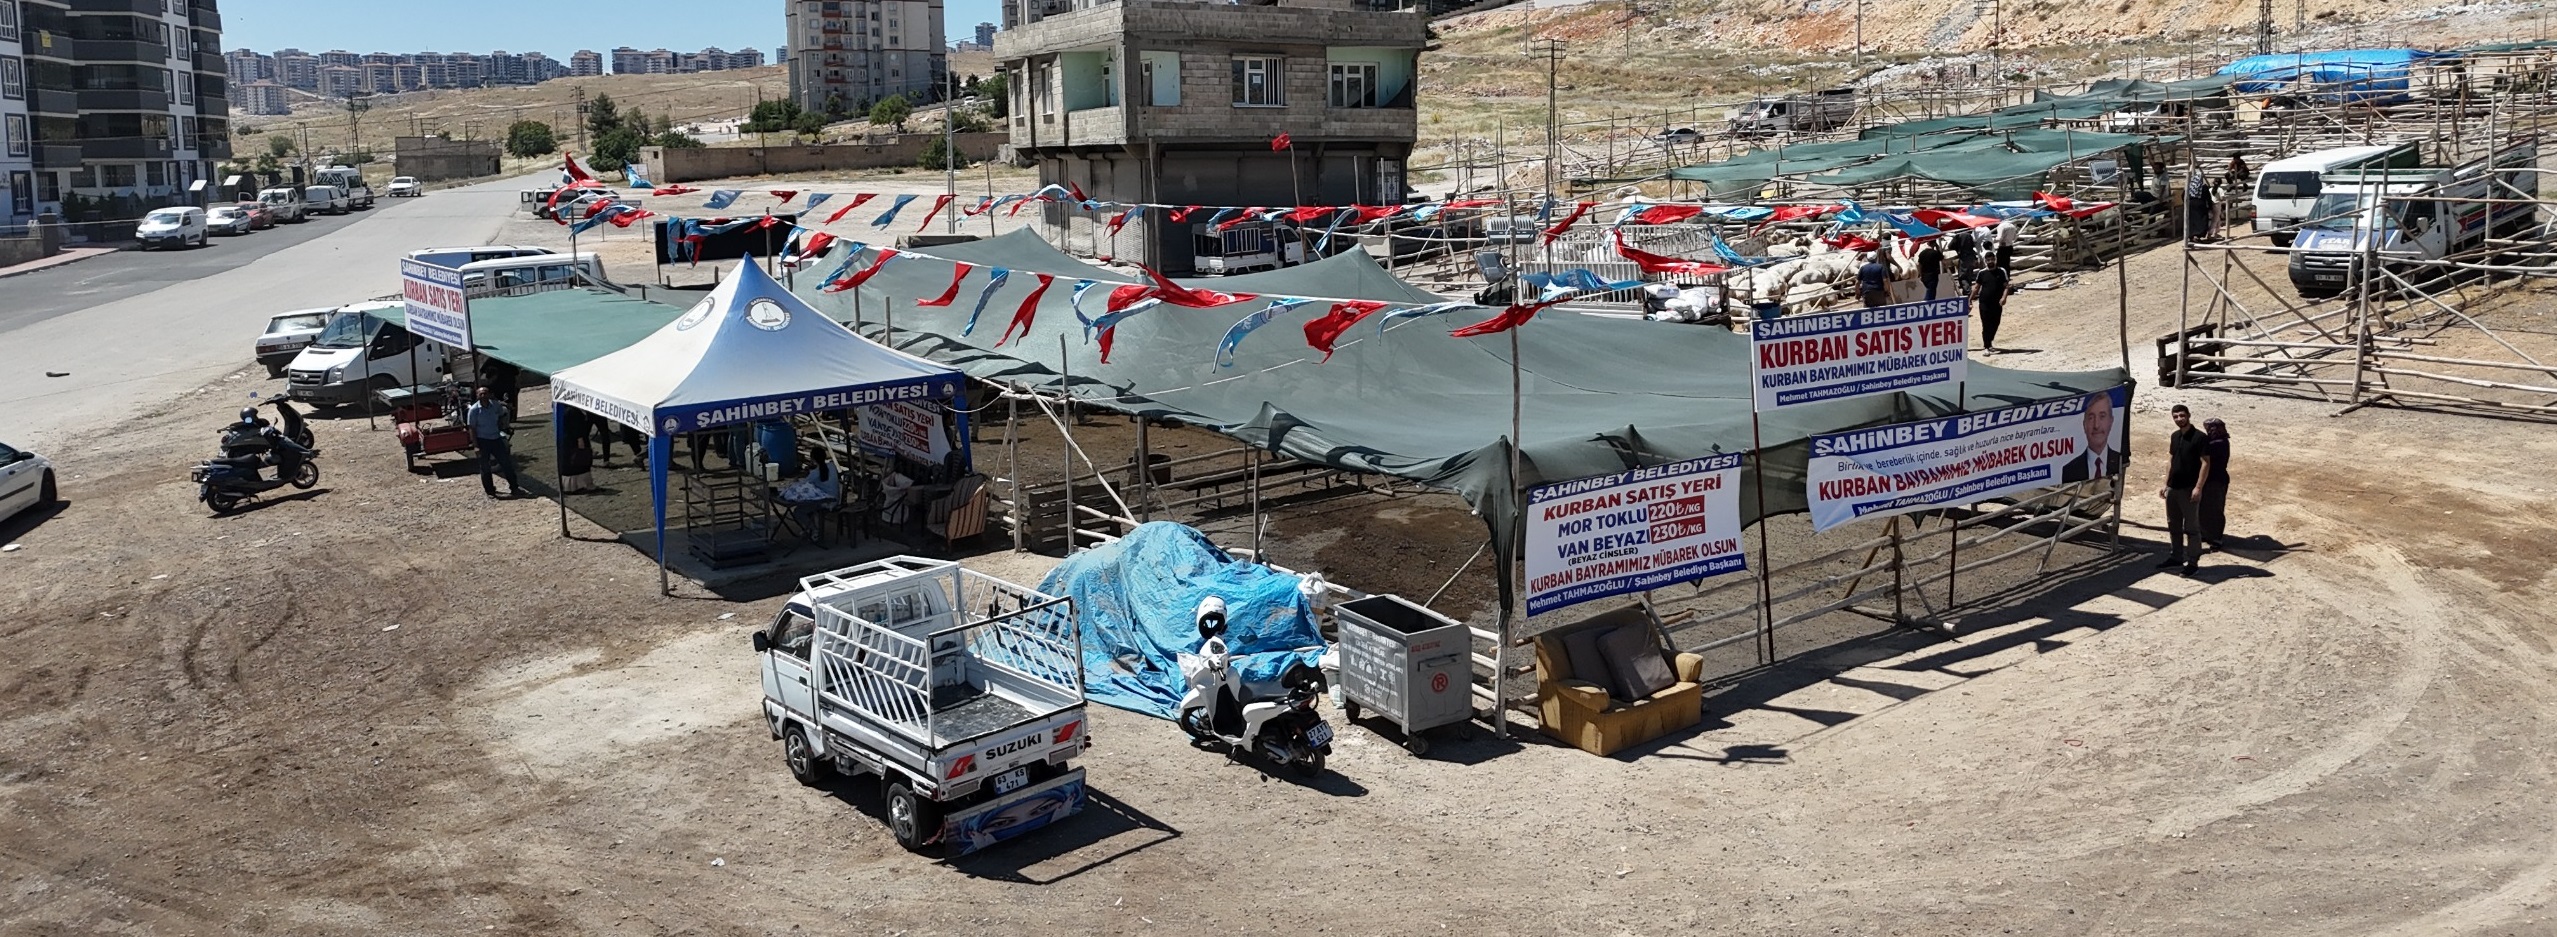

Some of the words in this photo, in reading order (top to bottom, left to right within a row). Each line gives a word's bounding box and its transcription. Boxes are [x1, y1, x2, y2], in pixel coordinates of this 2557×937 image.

[404, 278, 427, 304] KURBAN
[428, 285, 447, 312] SATIŞ
[446, 290, 463, 314] YERİ
[1758, 314, 1855, 339] ŞAHİNBEY
[1860, 299, 1964, 326] BELEDİYESİ
[1759, 334, 1848, 370] KURBAN
[1855, 326, 1913, 357] SATIŞ
[1918, 319, 1963, 349] YERİ
[1762, 370, 1807, 389] KURBAN
[1809, 361, 1875, 382] BAYRAMIMIZ
[1877, 354, 1927, 372] MÜBAREK
[1929, 349, 1963, 365] OLSUN
[1779, 392, 1808, 403] Mehmet
[1809, 384, 1855, 399] TAHMAZOĞLU
[1861, 380, 1892, 392] Şahinbey
[1893, 375, 1921, 387] Belediye
[1922, 371, 1947, 382] Başkanı
[594, 399, 639, 427] BELEDİYESİ
[696, 397, 808, 428] ŞAHİNBEY
[813, 381, 928, 409] BELEDİYESİ
[917, 411, 934, 427] YERİ
[1815, 421, 1949, 456] ŞAHİNBEY
[1957, 397, 2086, 435] BELEDİYESİ
[1975, 436, 1999, 449] huzurla
[2000, 434, 2014, 443] nice
[1532, 472, 1629, 503] ŞAHİNBEY
[1633, 454, 1739, 481] BELEDİYESİ
[1819, 475, 1891, 501] KURBAN
[1972, 444, 2027, 473] MÜBAREK
[2030, 437, 2074, 461] OLSUN
[1955, 480, 1985, 496] Şahinbey
[1985, 475, 2016, 489] Belediye
[2017, 468, 2048, 481] Başkanı
[1543, 492, 1621, 522] KURBAN
[1625, 482, 1677, 505] SATIŞ
[1681, 473, 1721, 495] YERİ
[1558, 518, 1592, 537] MOR
[1596, 507, 1648, 530] TOKLU
[1557, 540, 1589, 559] VAN
[1593, 529, 1650, 552] BEYAZI
[1568, 554, 1597, 567] (BEYAZ
[1599, 546, 1639, 560] CİNSLER)
[1530, 569, 1573, 594] KURBAN
[1575, 556, 1650, 581] BAYRAMIMIZ
[1652, 544, 1698, 569] MÜBAREK
[1701, 538, 1737, 557] OLSUN
[1529, 595, 1562, 611] Mehmet
[1562, 579, 1625, 601] TAHMAZOĞLU
[1626, 579, 1632, 589] /
[1634, 572, 1672, 588] Şahinbey
[1673, 565, 1708, 580] Belediye
[1709, 559, 1742, 572] Başkanı
[985, 733, 1041, 760] SUZUKI
[1316, 732, 1328, 743] 521
[997, 776, 1007, 785] 63
[1015, 768, 1025, 778] KS
[1006, 779, 1019, 790] 471
